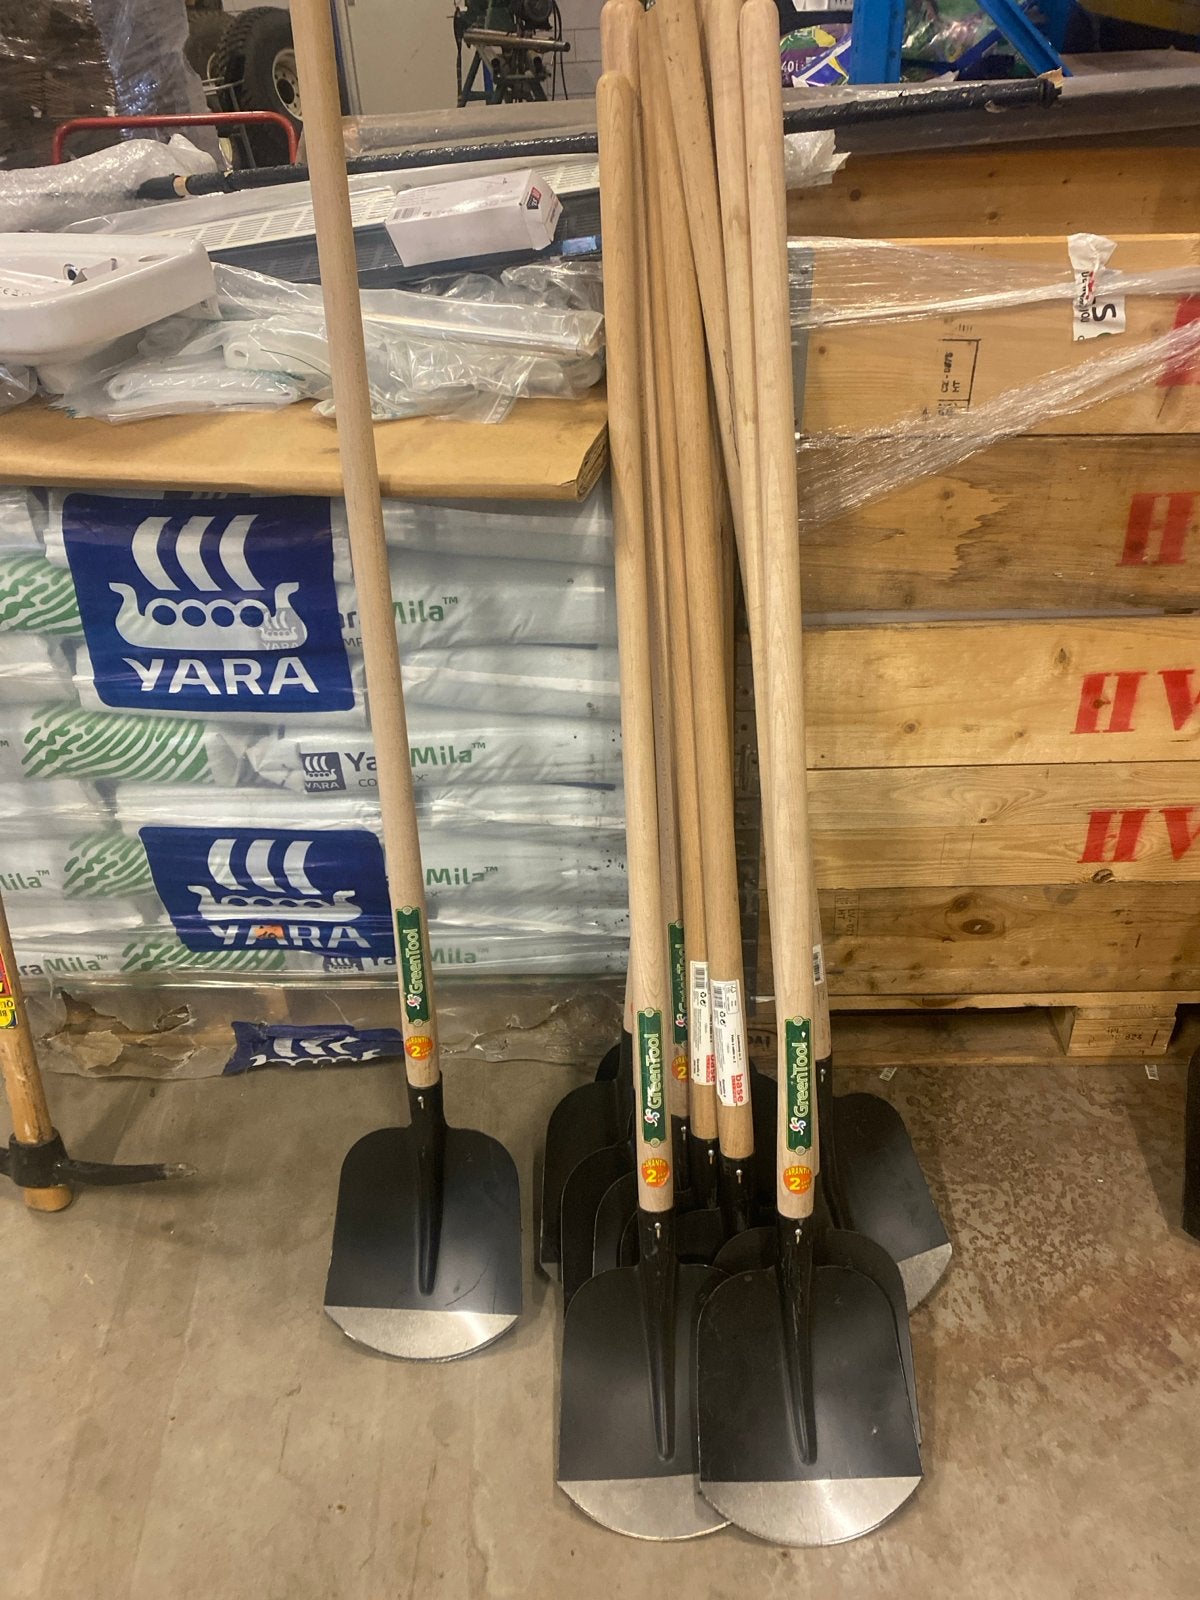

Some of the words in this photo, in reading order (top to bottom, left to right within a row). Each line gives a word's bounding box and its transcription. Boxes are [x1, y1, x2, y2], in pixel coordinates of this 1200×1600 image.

[122, 656, 319, 695] YARA
[207, 925, 371, 948] YARA
[402, 928, 424, 995] GreenTool
[411, 1046, 421, 1057] 2
[644, 1033, 662, 1110] GreenTool
[677, 1066, 687, 1080] 2
[792, 1041, 809, 1118] GreenTool
[736, 1073, 744, 1103] base
[646, 1169, 657, 1183] 2
[789, 1178, 801, 1190] 2
